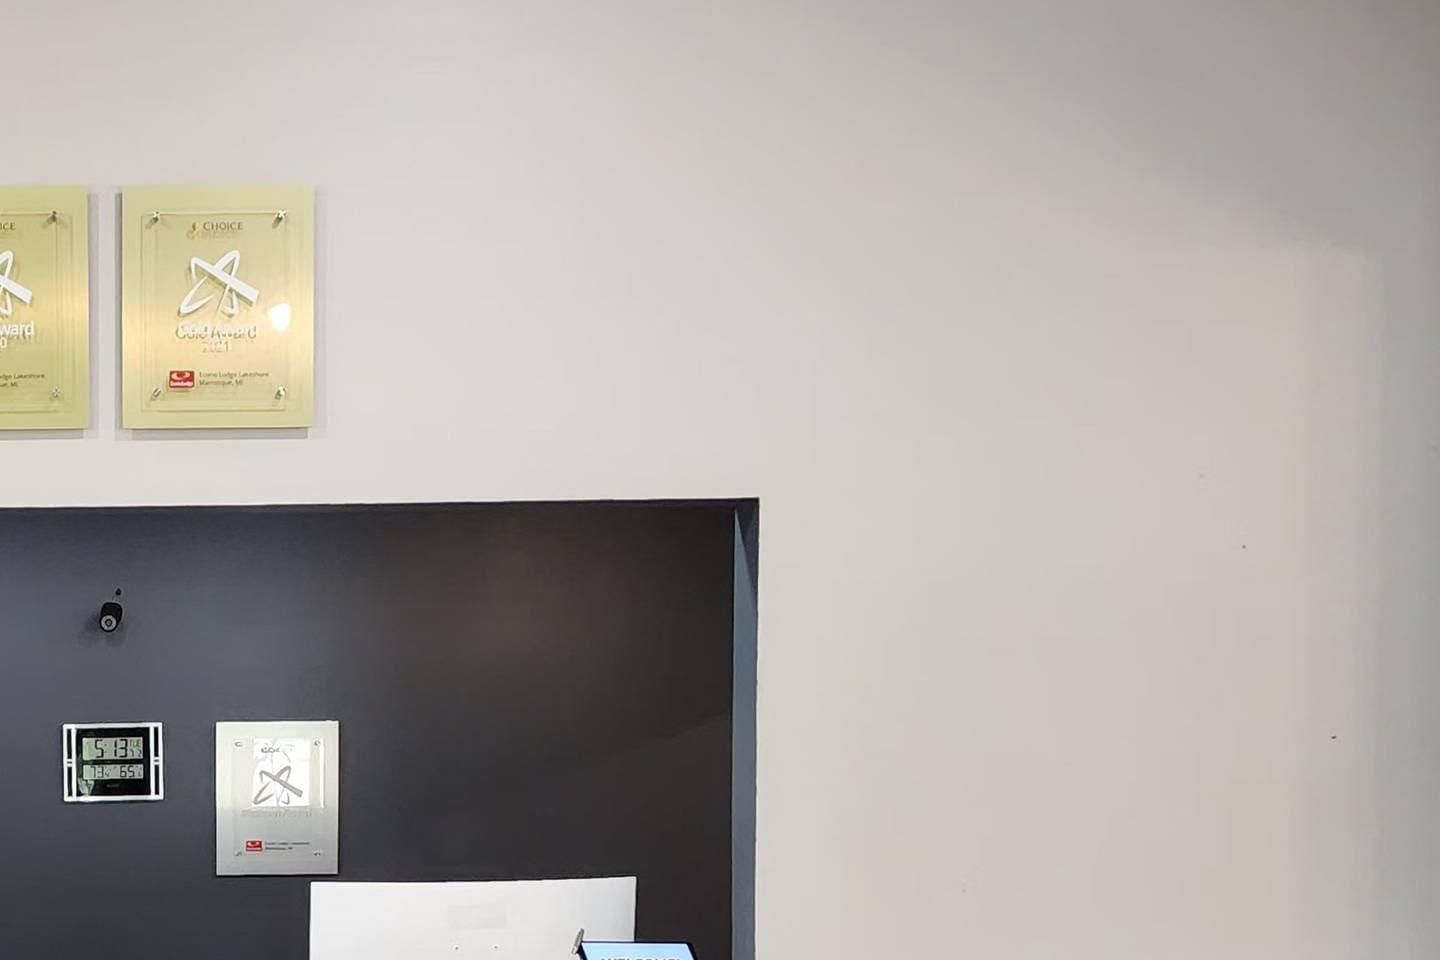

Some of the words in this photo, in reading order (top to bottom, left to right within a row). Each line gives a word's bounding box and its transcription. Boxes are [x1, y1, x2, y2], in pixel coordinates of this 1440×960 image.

[203, 221, 244, 231] CHOICE
[176, 321, 209, 339] Gold
[211, 321, 257, 339] Award
